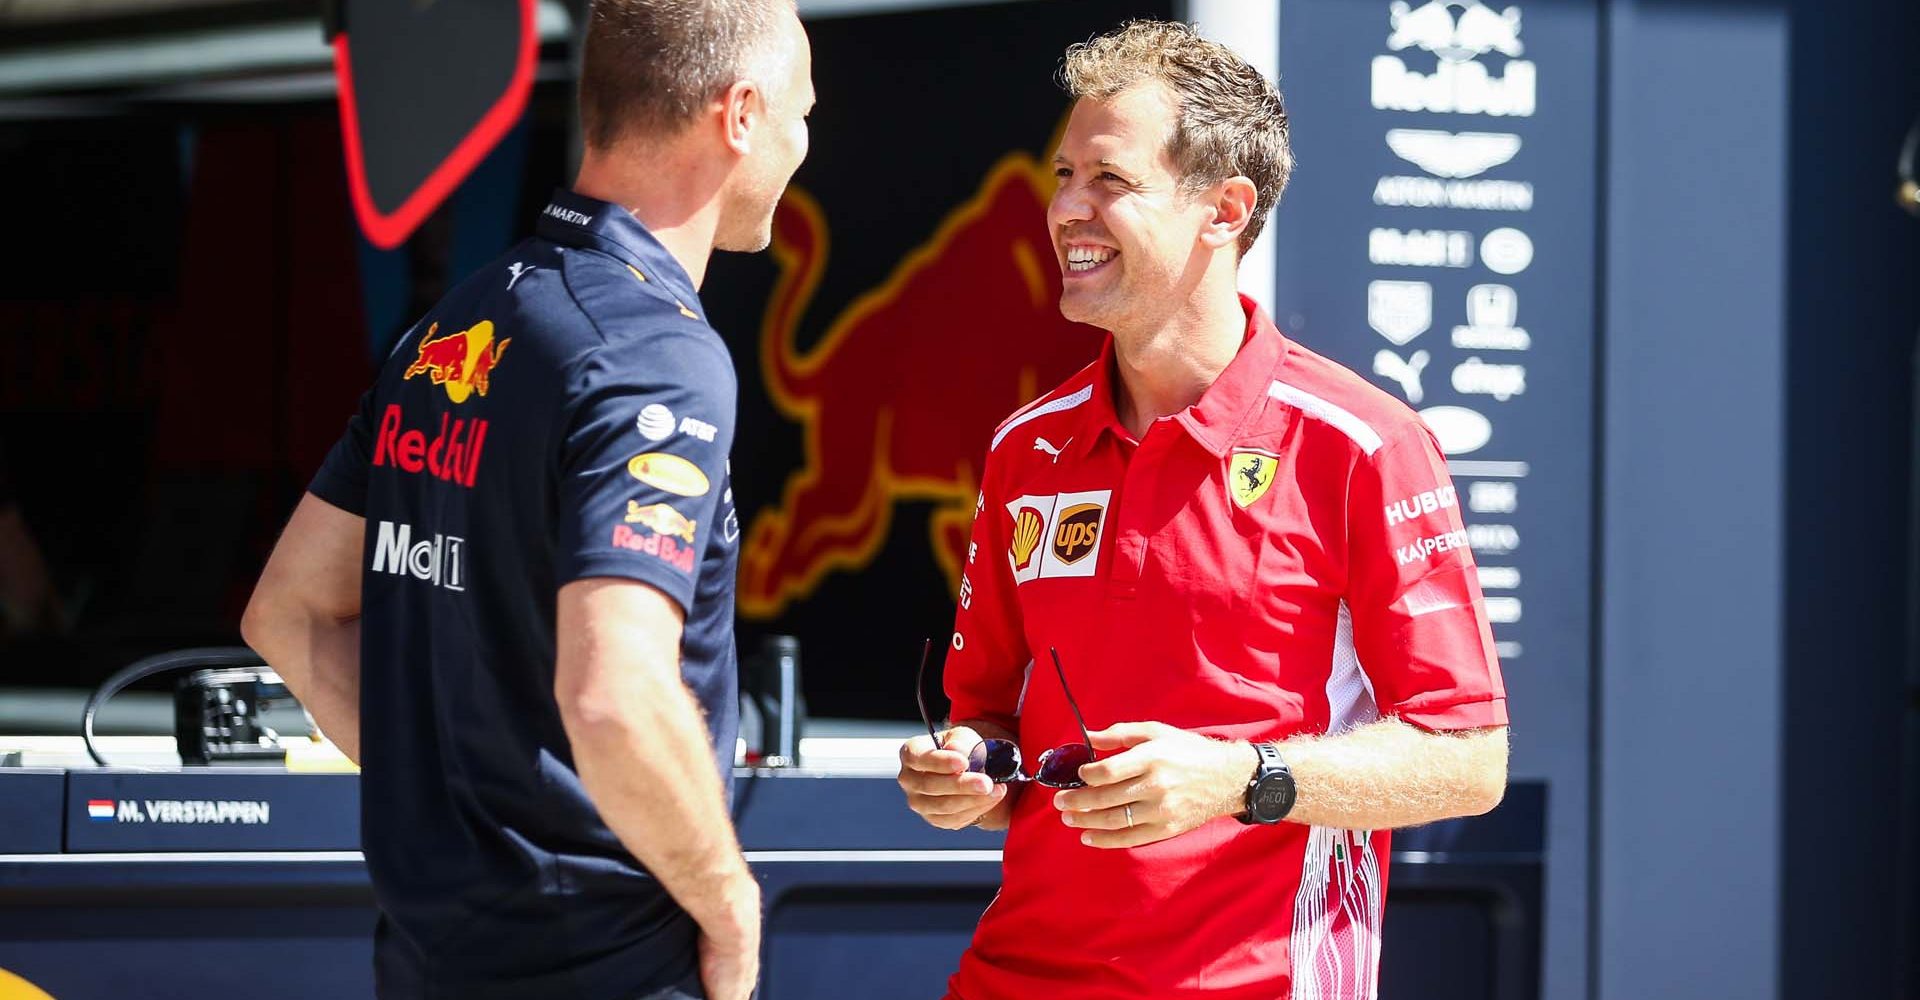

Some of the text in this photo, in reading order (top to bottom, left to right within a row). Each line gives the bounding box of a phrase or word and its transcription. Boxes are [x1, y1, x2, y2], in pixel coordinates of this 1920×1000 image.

[550, 204, 593, 226] MARTIN
[1056, 522, 1098, 556] ups
[117, 799, 270, 825] M. VERSTAPPEN
